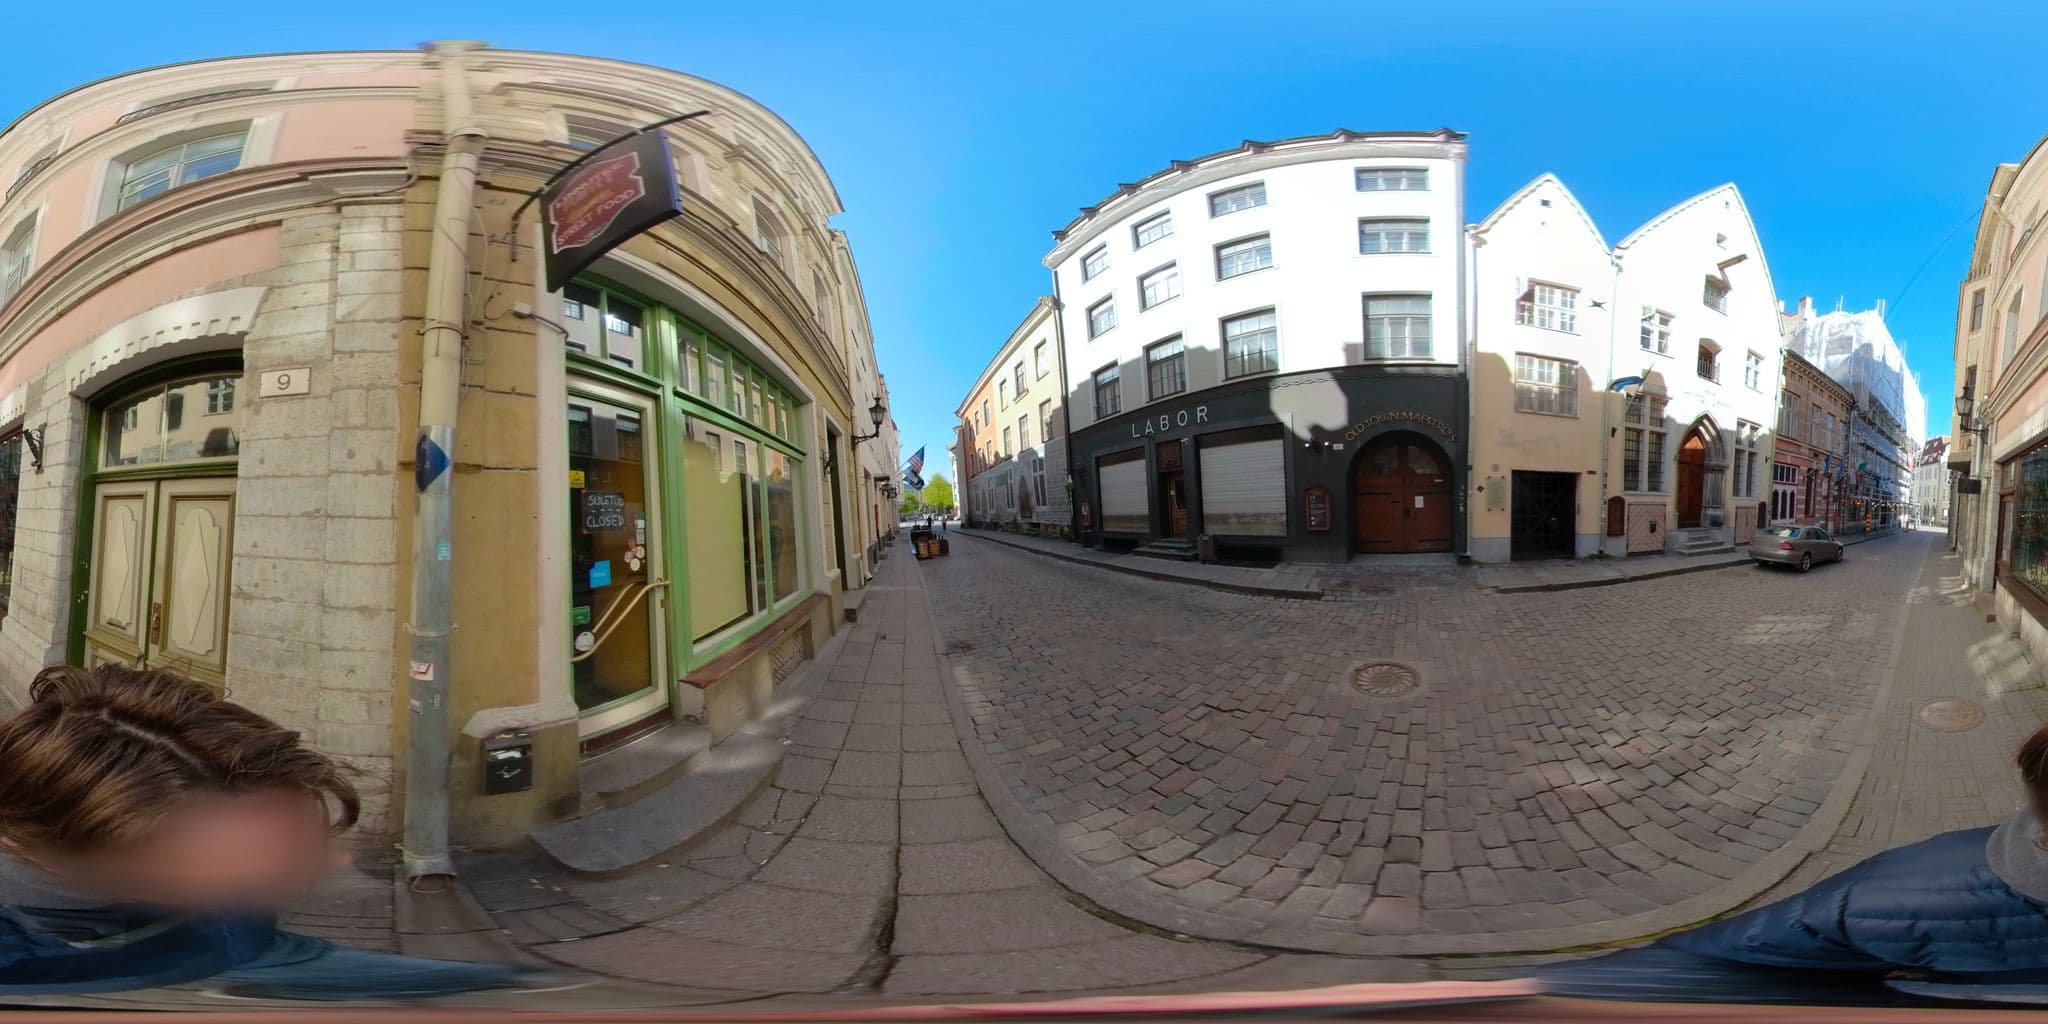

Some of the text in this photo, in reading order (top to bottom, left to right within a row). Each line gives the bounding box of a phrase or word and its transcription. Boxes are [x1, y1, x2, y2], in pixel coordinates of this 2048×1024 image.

[597, 189, 635, 215] FOOD
[277, 373, 291, 391] 9
[1131, 405, 1208, 438] LABOR
[1345, 423, 1365, 441] OLD
[1364, 411, 1400, 428] TOWN
[586, 515, 625, 528] CLOSED
